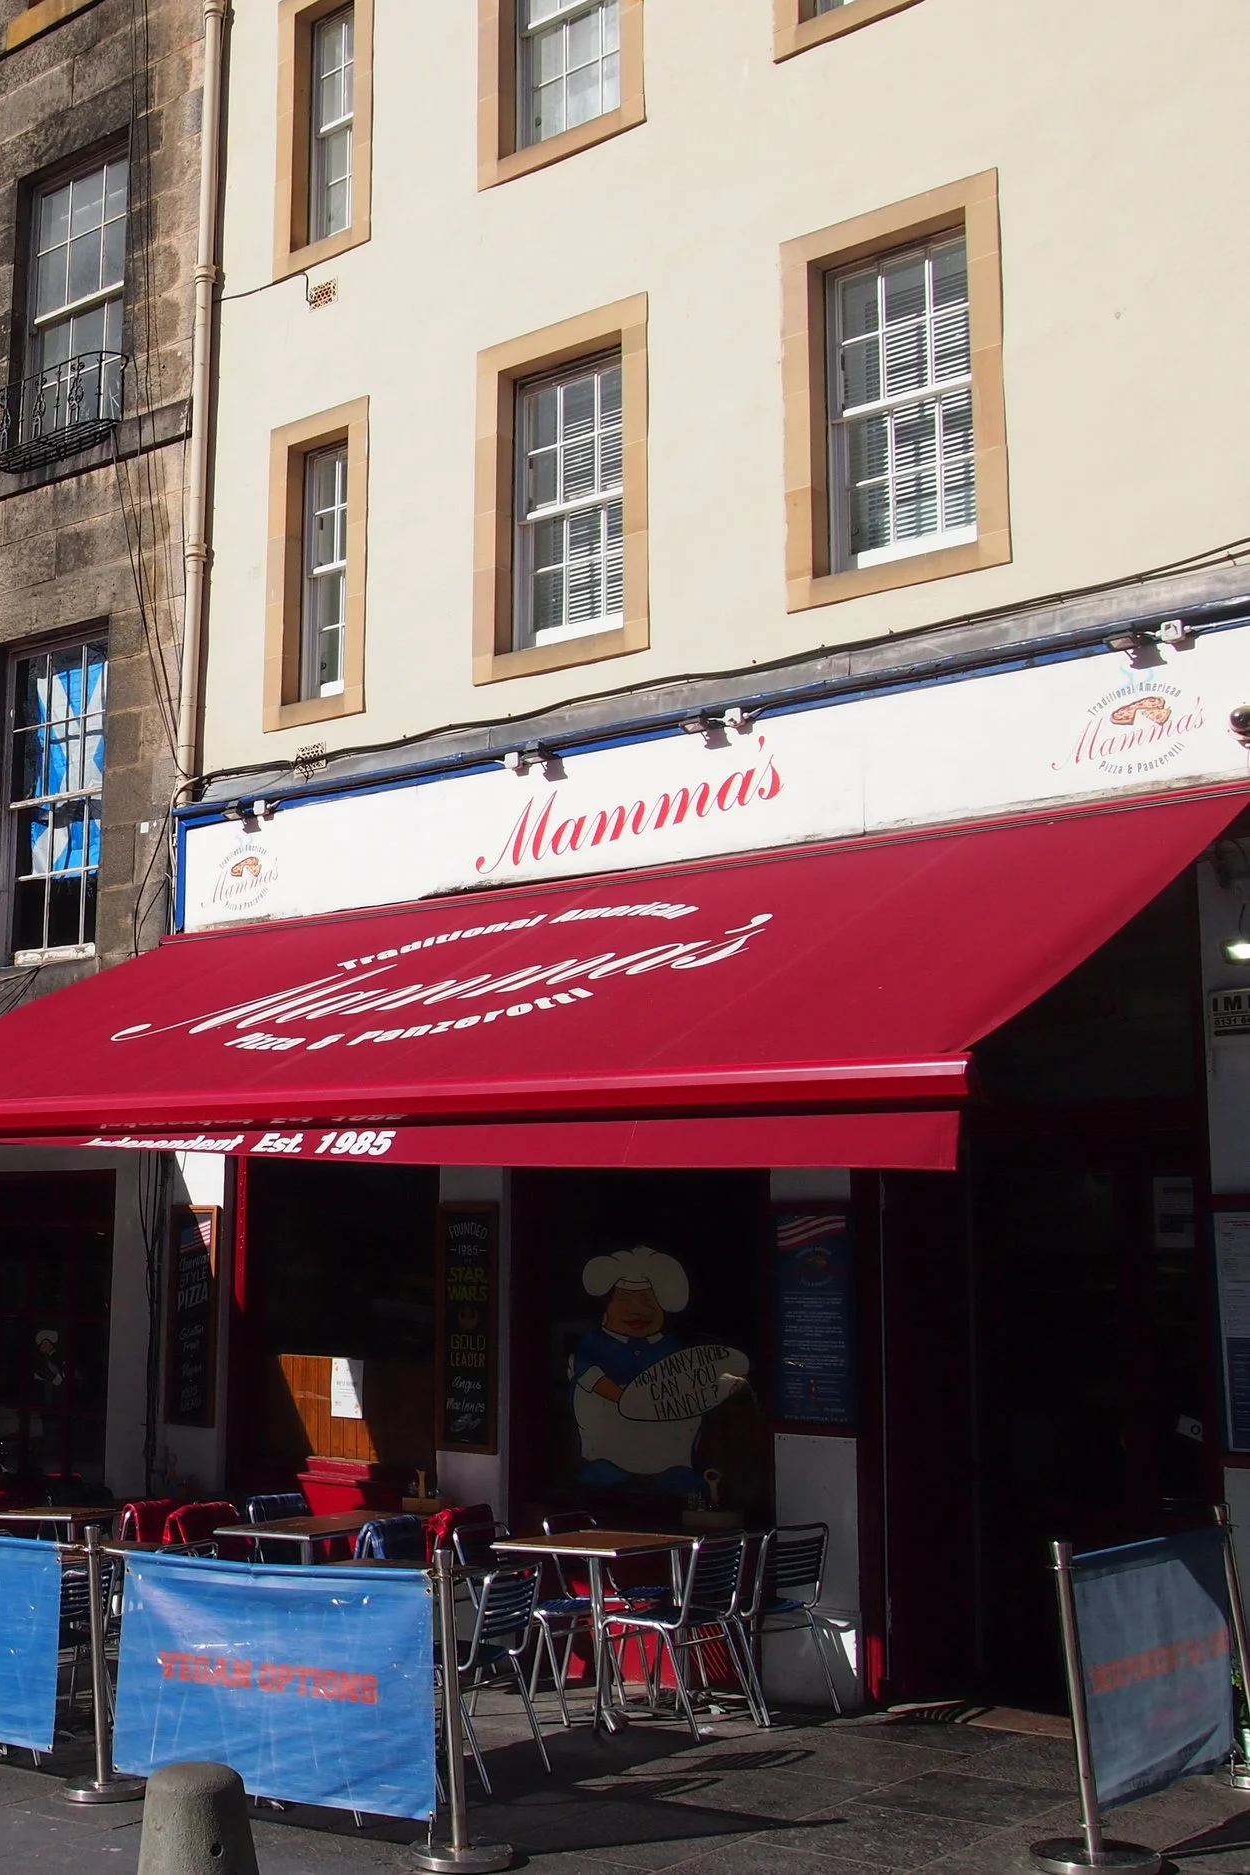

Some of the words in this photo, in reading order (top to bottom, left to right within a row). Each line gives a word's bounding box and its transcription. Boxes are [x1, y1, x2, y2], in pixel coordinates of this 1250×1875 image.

[1139, 682, 1181, 698] American
[1050, 696, 1206, 771] Mamma's
[1098, 760, 1122, 775] Pizza
[475, 736, 784, 874] Mamma's
[337, 914, 548, 970] Traditional
[111, 913, 774, 1042] Mamma's
[223, 1031, 306, 1051] Pizza
[345, 987, 594, 1046] Panzerotti
[251, 1133, 303, 1152] Est.
[314, 1130, 397, 1156] 1985
[449, 1222, 488, 1240] FOUNDED
[179, 1266, 208, 1287] STYLE
[447, 1266, 488, 1283] STAR
[177, 1281, 209, 1312] PIZZA
[447, 1284, 488, 1301] WARS
[450, 1334, 486, 1351] GOLD
[450, 1351, 486, 1368] LEADER
[634, 1365, 658, 1388] HOW
[659, 1349, 694, 1378] MANY
[650, 1376, 680, 1401] CAN
[685, 1364, 717, 1389] YOU
[158, 1651, 254, 1689] VEGAN
[258, 1661, 379, 1704] OPTIONS
